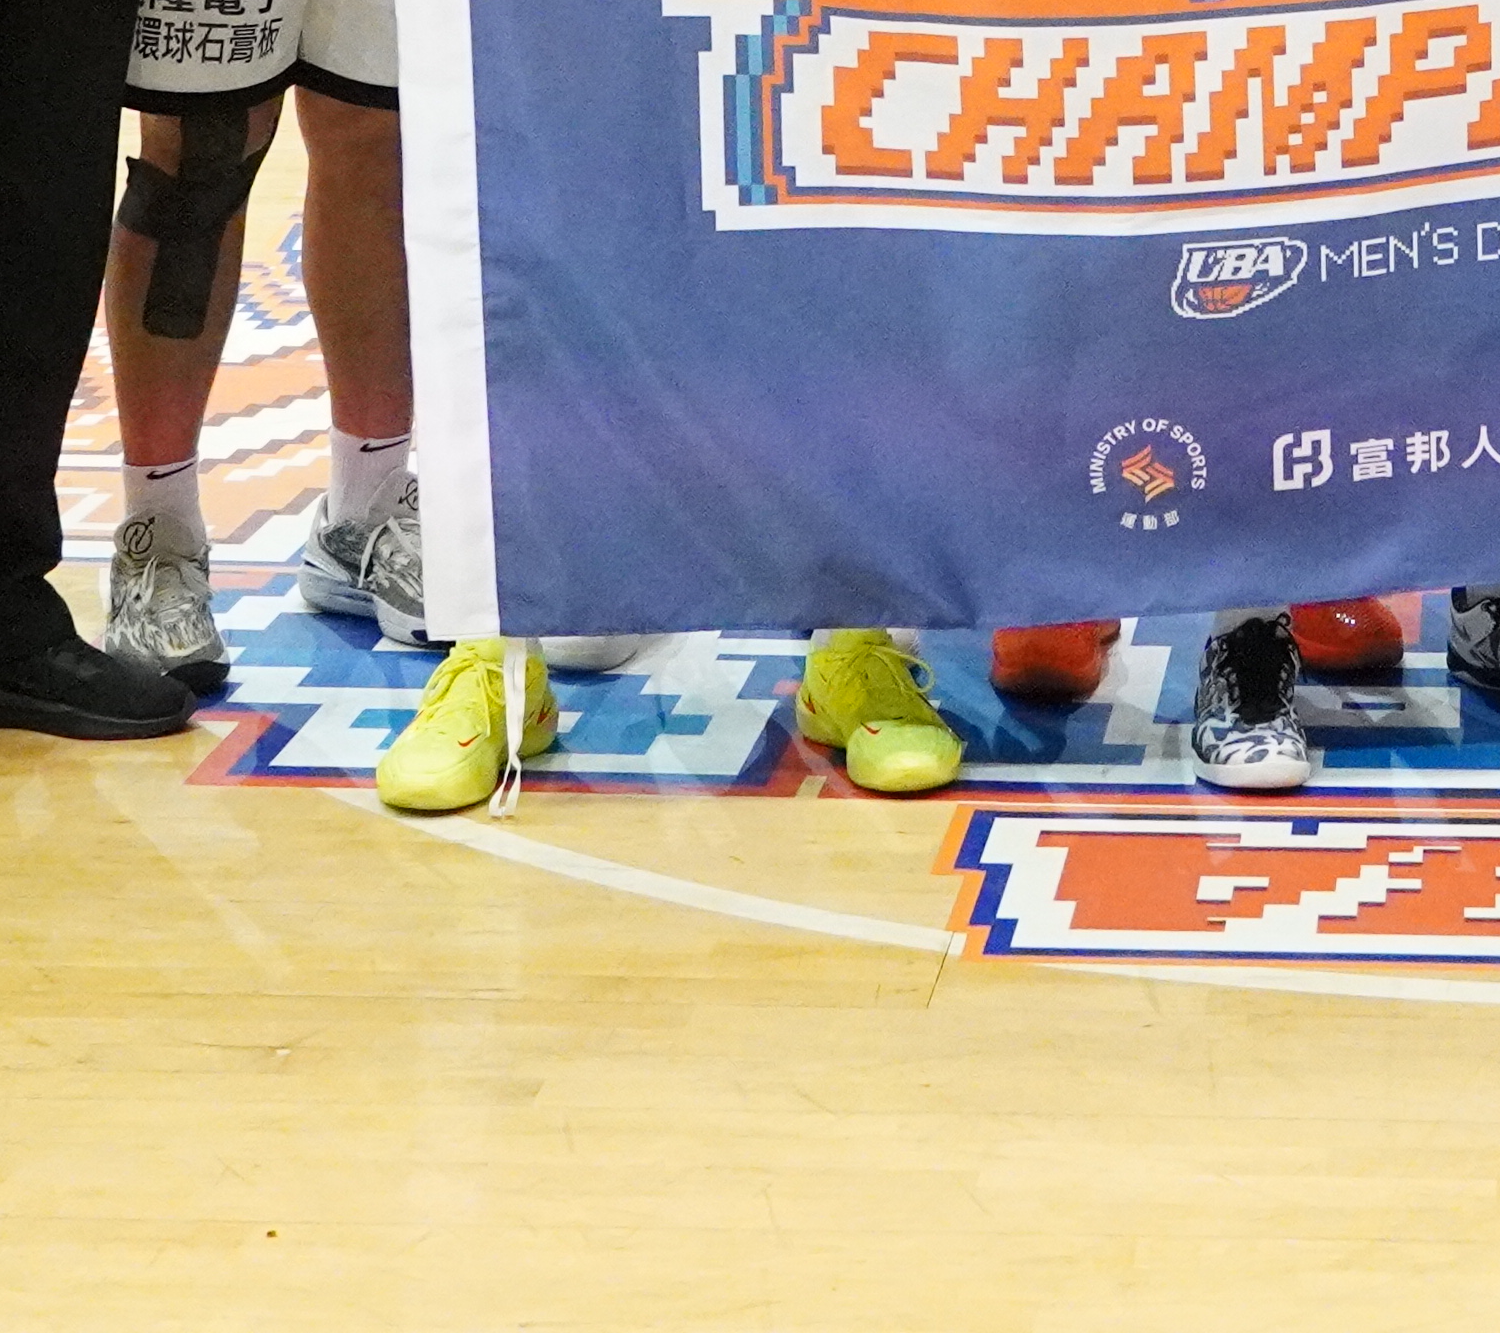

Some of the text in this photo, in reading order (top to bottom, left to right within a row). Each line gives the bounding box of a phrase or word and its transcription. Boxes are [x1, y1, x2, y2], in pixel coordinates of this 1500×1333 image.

[134, 15, 285, 64] 環球石膏板
[1186, 241, 1286, 282] UBA
[1319, 222, 1460, 282] MEN'S
[1089, 417, 1207, 494] MINISTRY OF SPORTS
